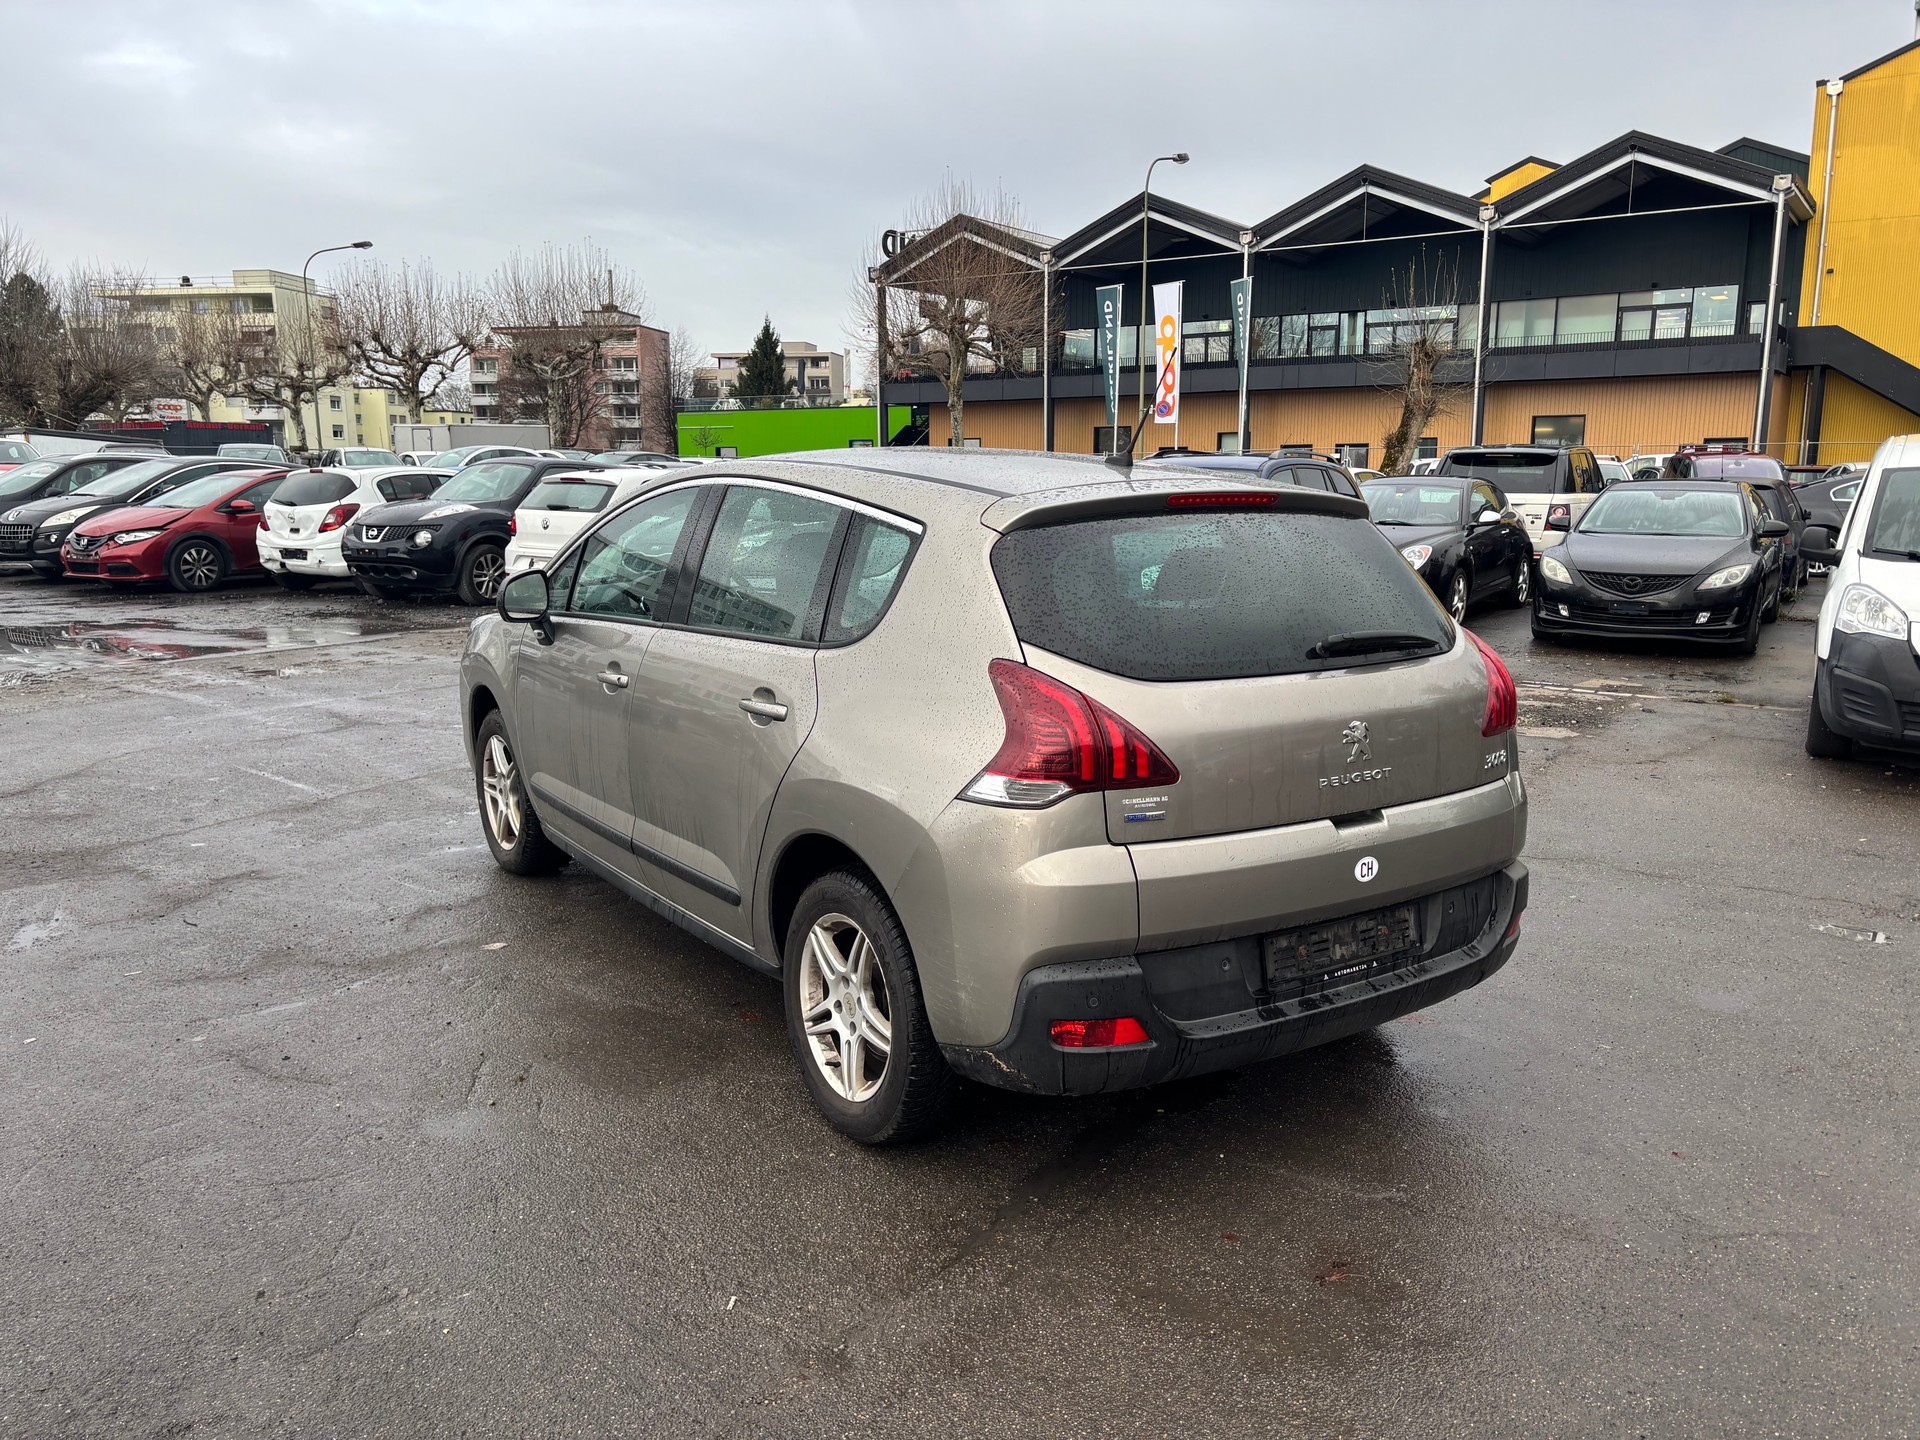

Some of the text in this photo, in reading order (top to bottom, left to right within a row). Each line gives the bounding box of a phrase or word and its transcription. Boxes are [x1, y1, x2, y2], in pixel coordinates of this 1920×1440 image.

[157, 403, 183, 412] coop
[1318, 767, 1392, 789] PEUGEOT
[1360, 860, 1374, 879] CH
